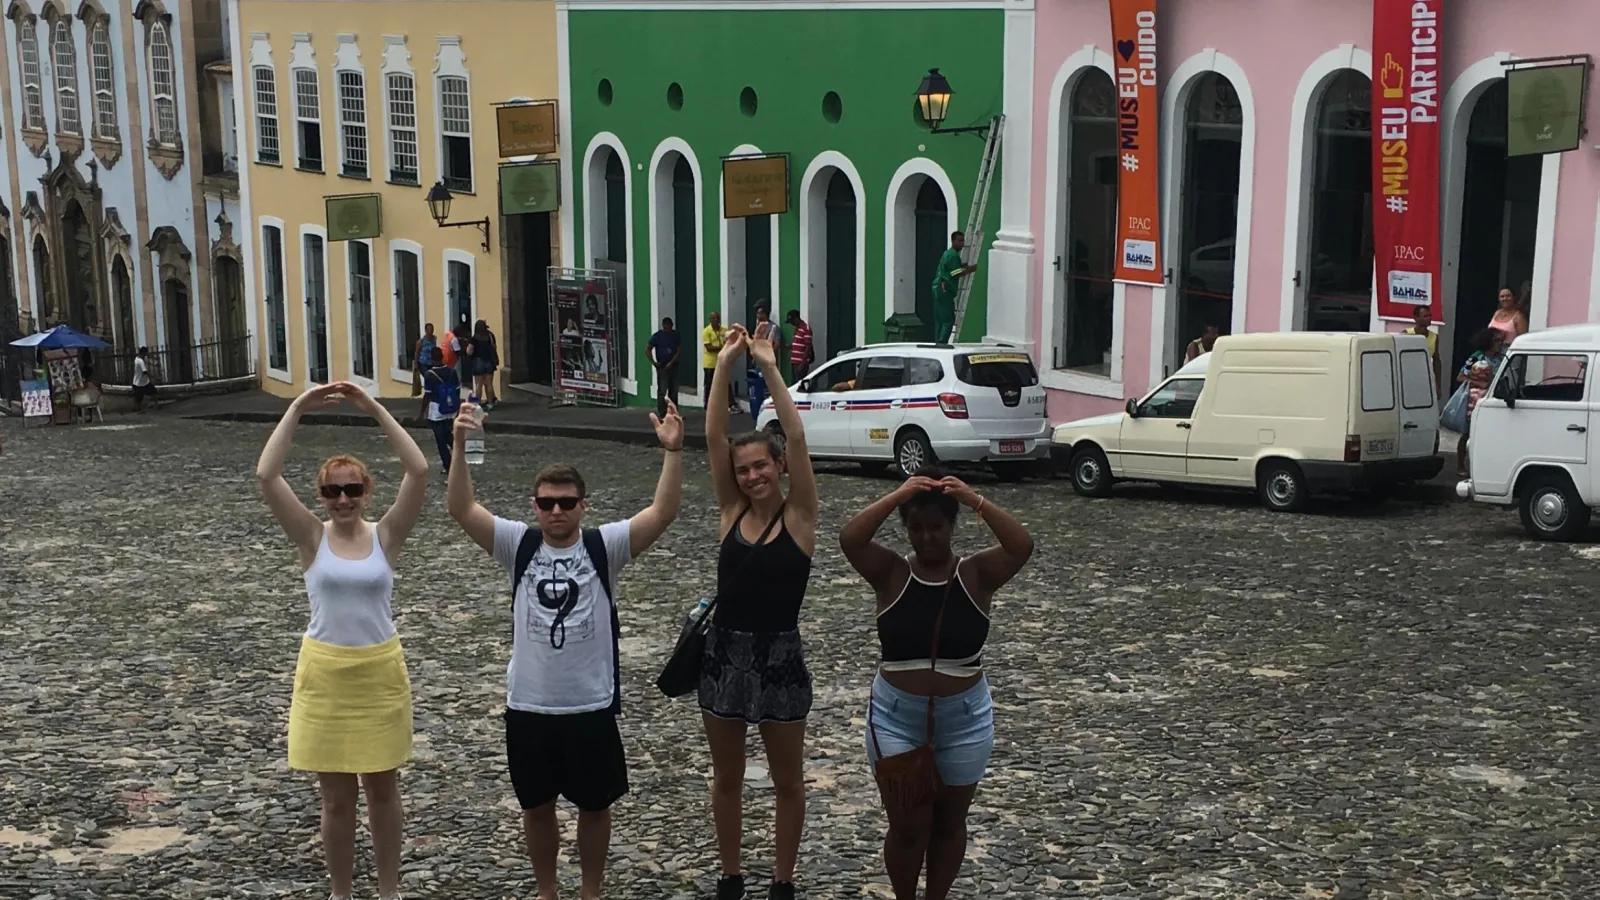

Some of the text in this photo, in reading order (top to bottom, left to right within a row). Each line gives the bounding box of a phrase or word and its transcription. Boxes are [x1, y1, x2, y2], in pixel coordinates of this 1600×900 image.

[1136, 11, 1156, 86] CUIDO
[1411, 0, 1438, 122] PARTICIP
[1119, 68, 1139, 172] #MUSEU
[1382, 107, 1409, 213] #MUSEU
[1128, 216, 1151, 230] IPAC
[1126, 253, 1151, 264] BAHIA
[1394, 245, 1425, 260] IPAC
[1392, 285, 1426, 298] BAHIA
